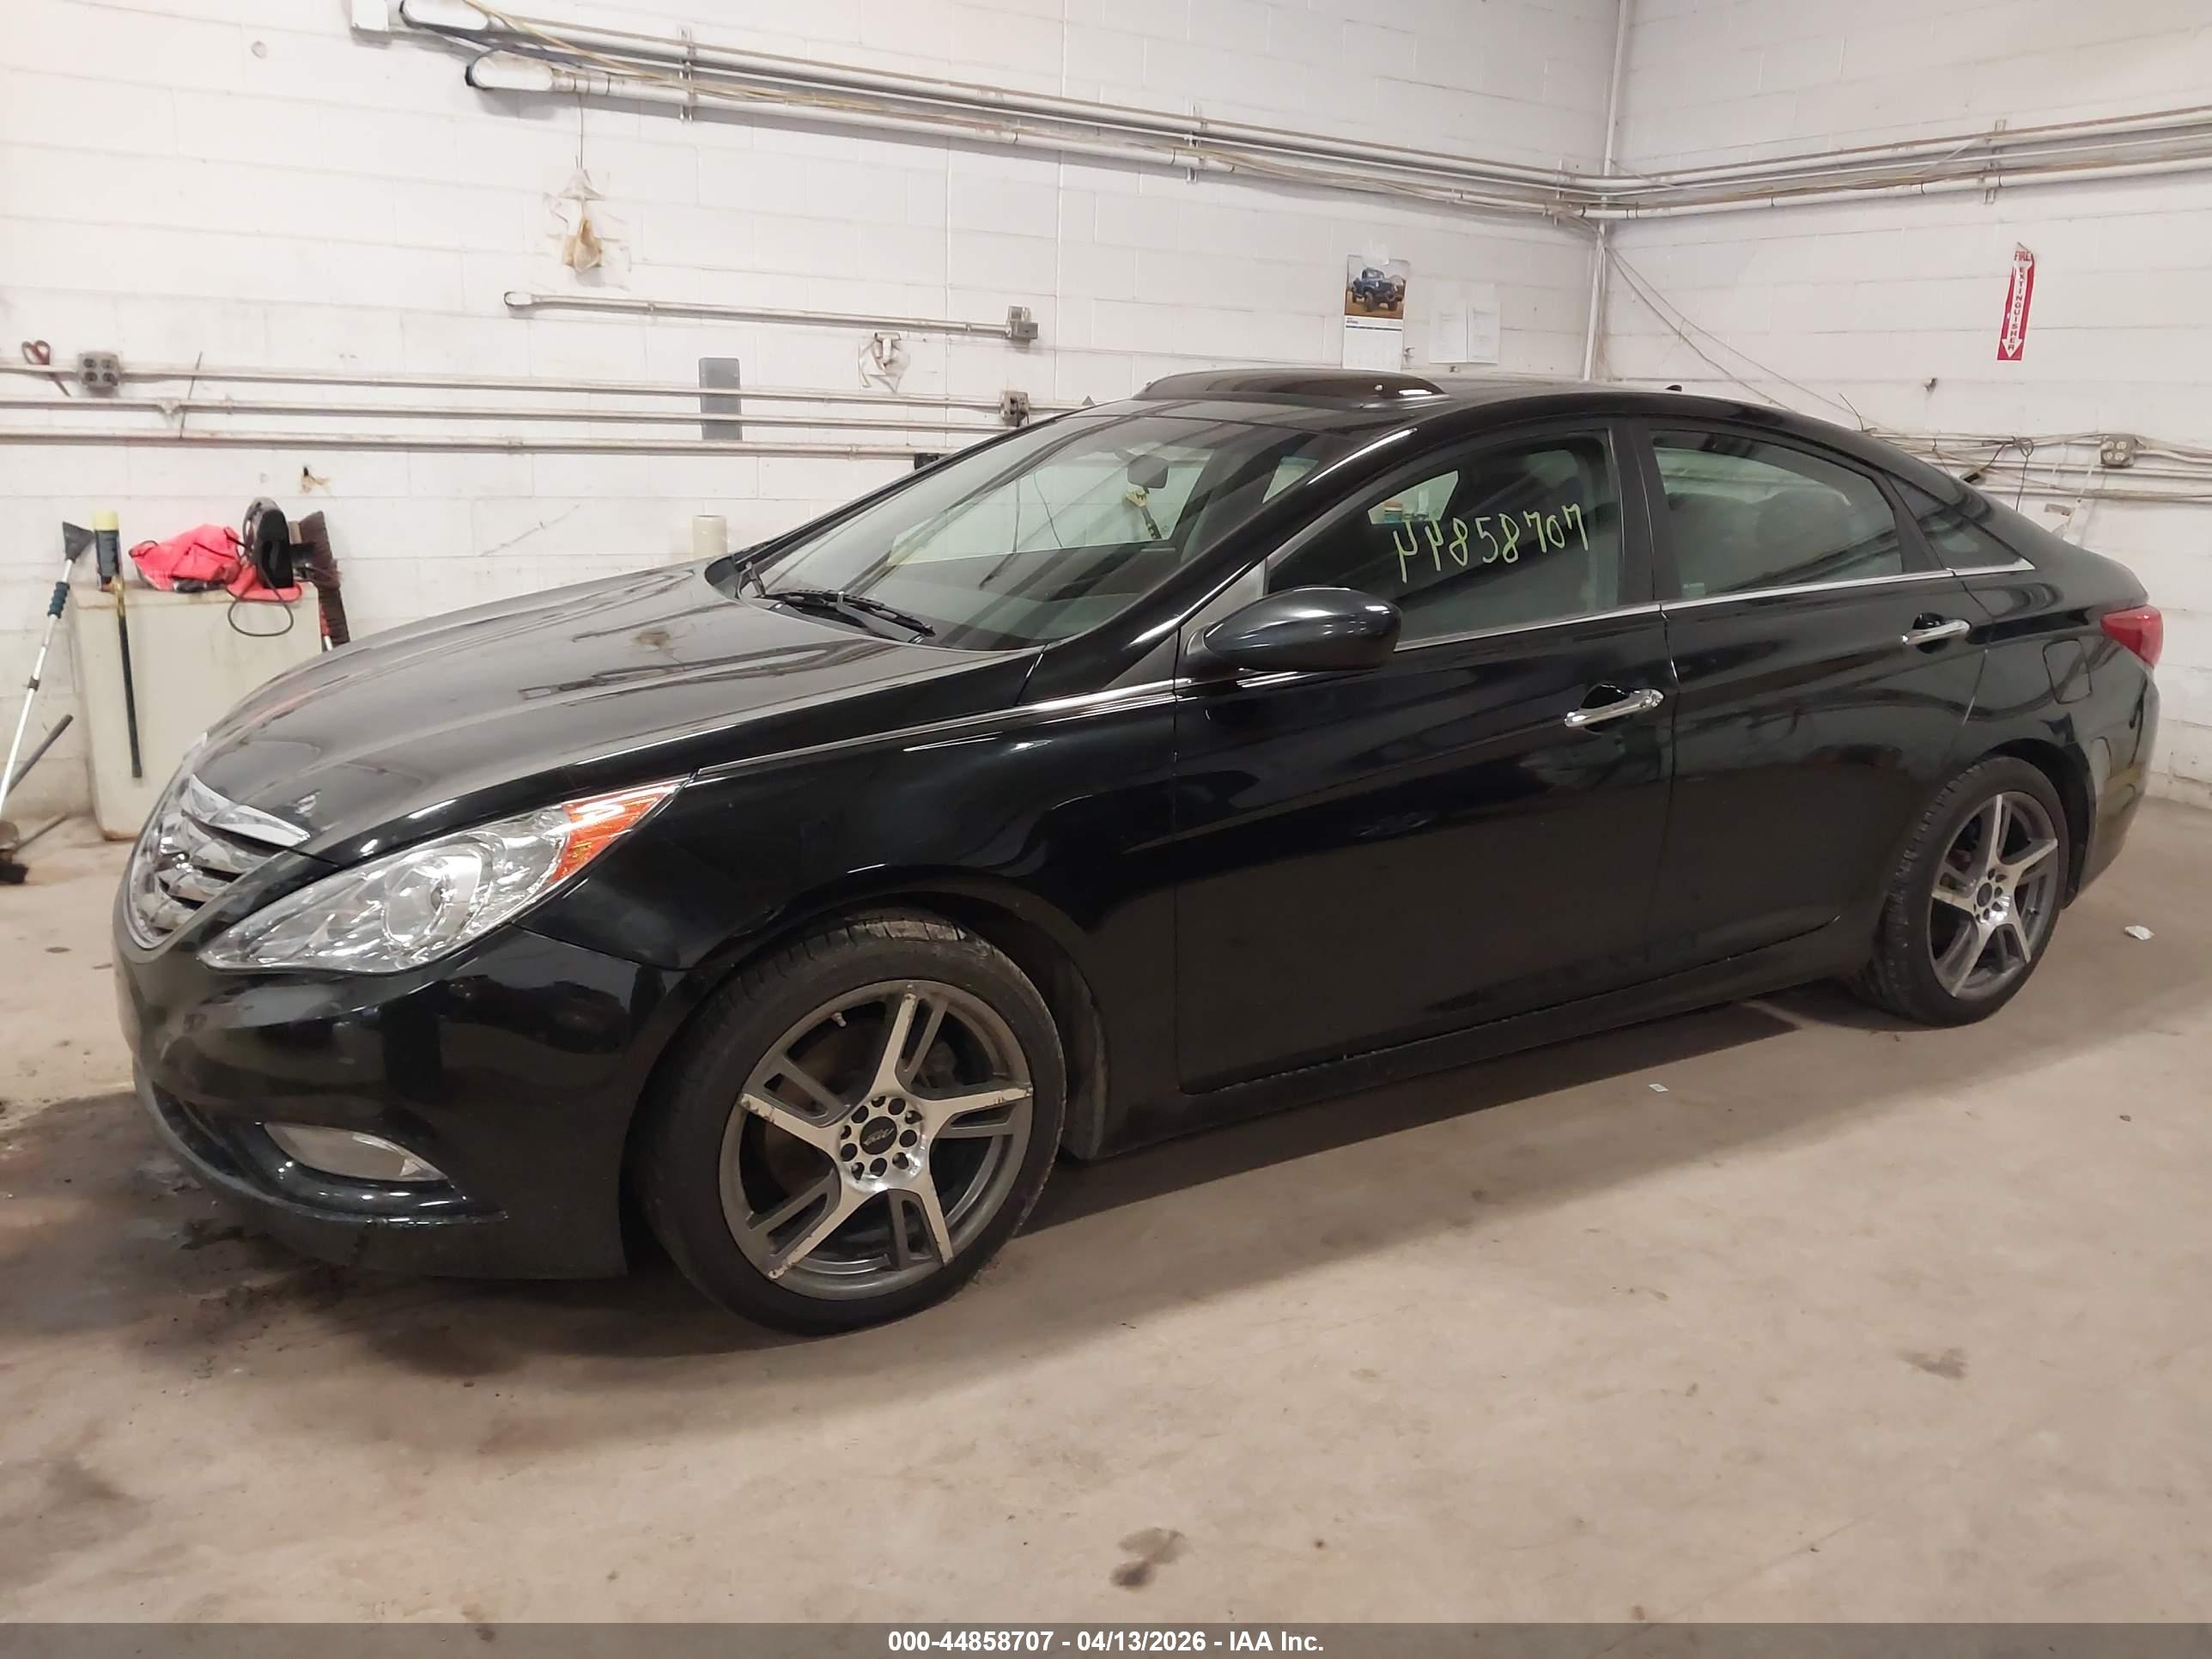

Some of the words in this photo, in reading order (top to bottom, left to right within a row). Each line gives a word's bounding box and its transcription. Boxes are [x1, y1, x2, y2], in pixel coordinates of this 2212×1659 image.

[2014, 250, 2031, 261] FIRE
[2008, 266, 2025, 350] EXTINGUISHER
[1393, 503, 1589, 584] 44858707
